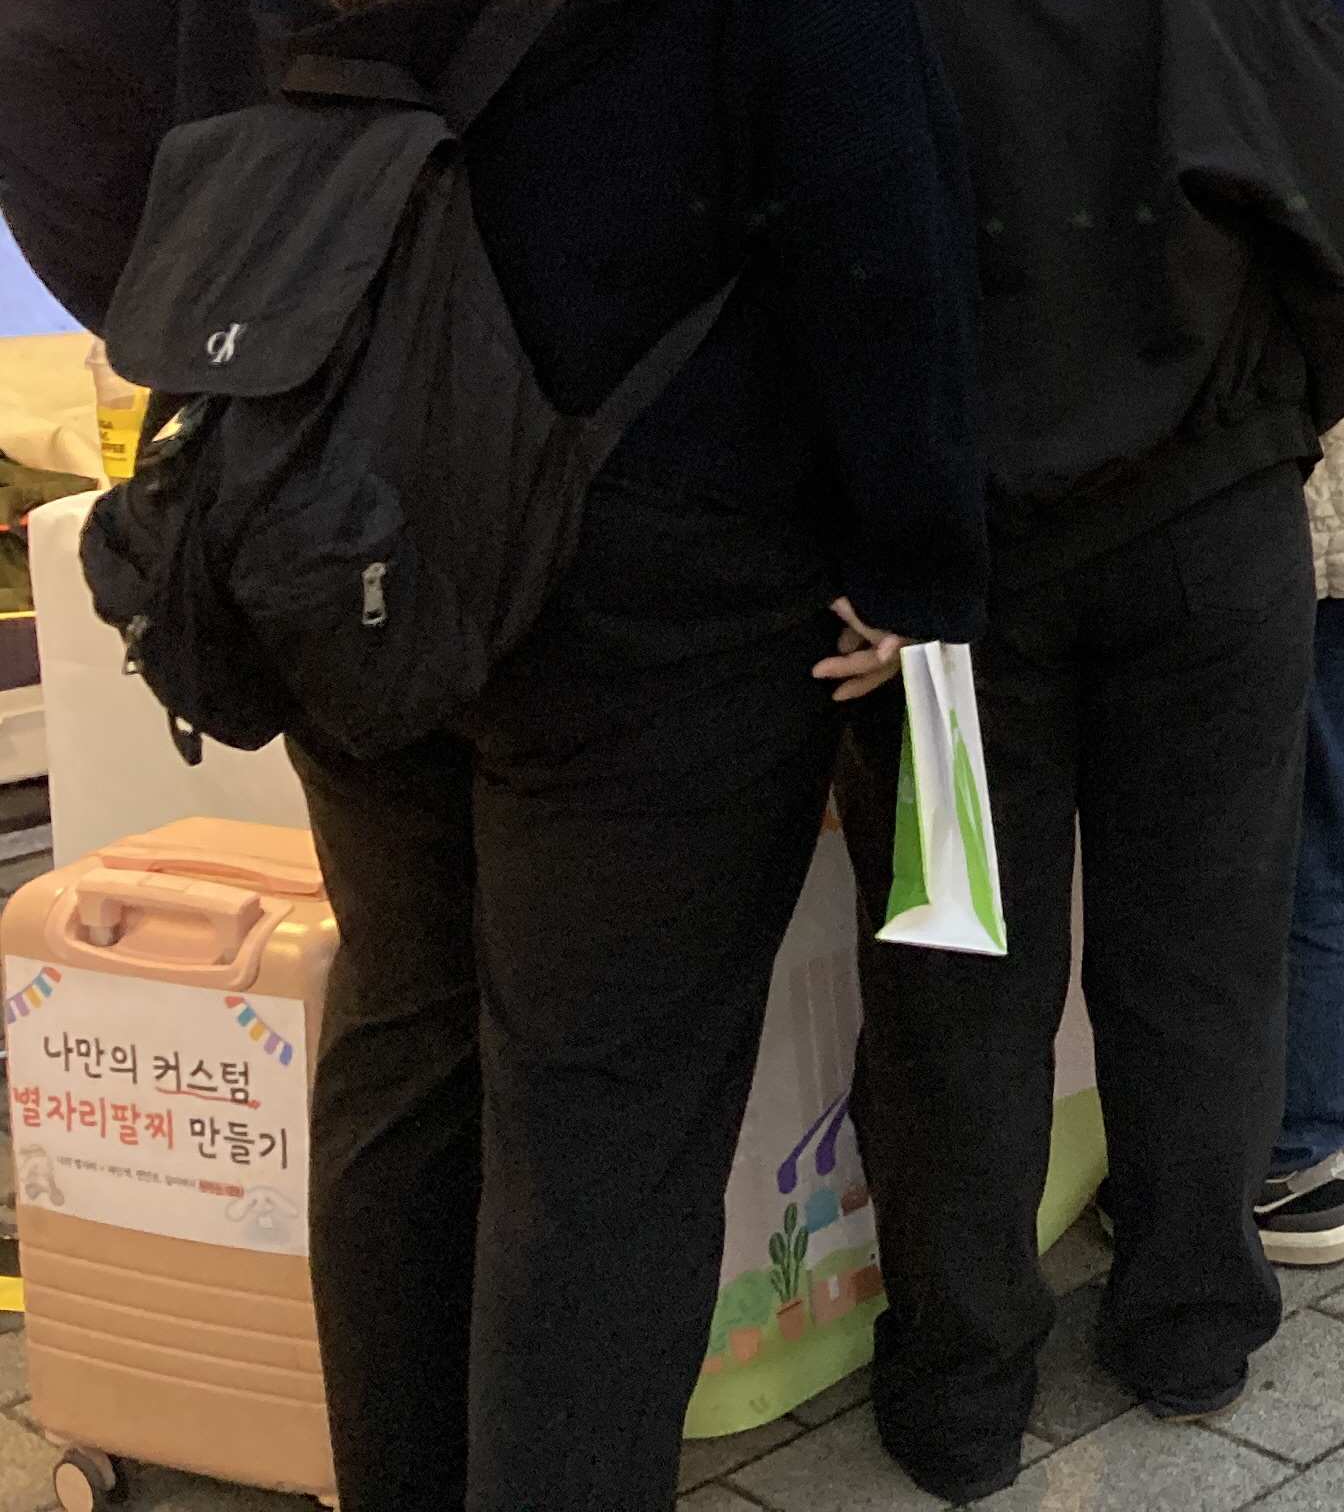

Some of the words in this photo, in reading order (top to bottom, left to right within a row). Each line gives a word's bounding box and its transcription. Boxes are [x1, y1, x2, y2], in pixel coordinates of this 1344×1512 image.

[43, 1031, 139, 1085] 나만의
[153, 1051, 251, 1105] 커스텀
[12, 1086, 175, 1151] 별자리팔찌
[189, 1116, 289, 1170] 만들기
